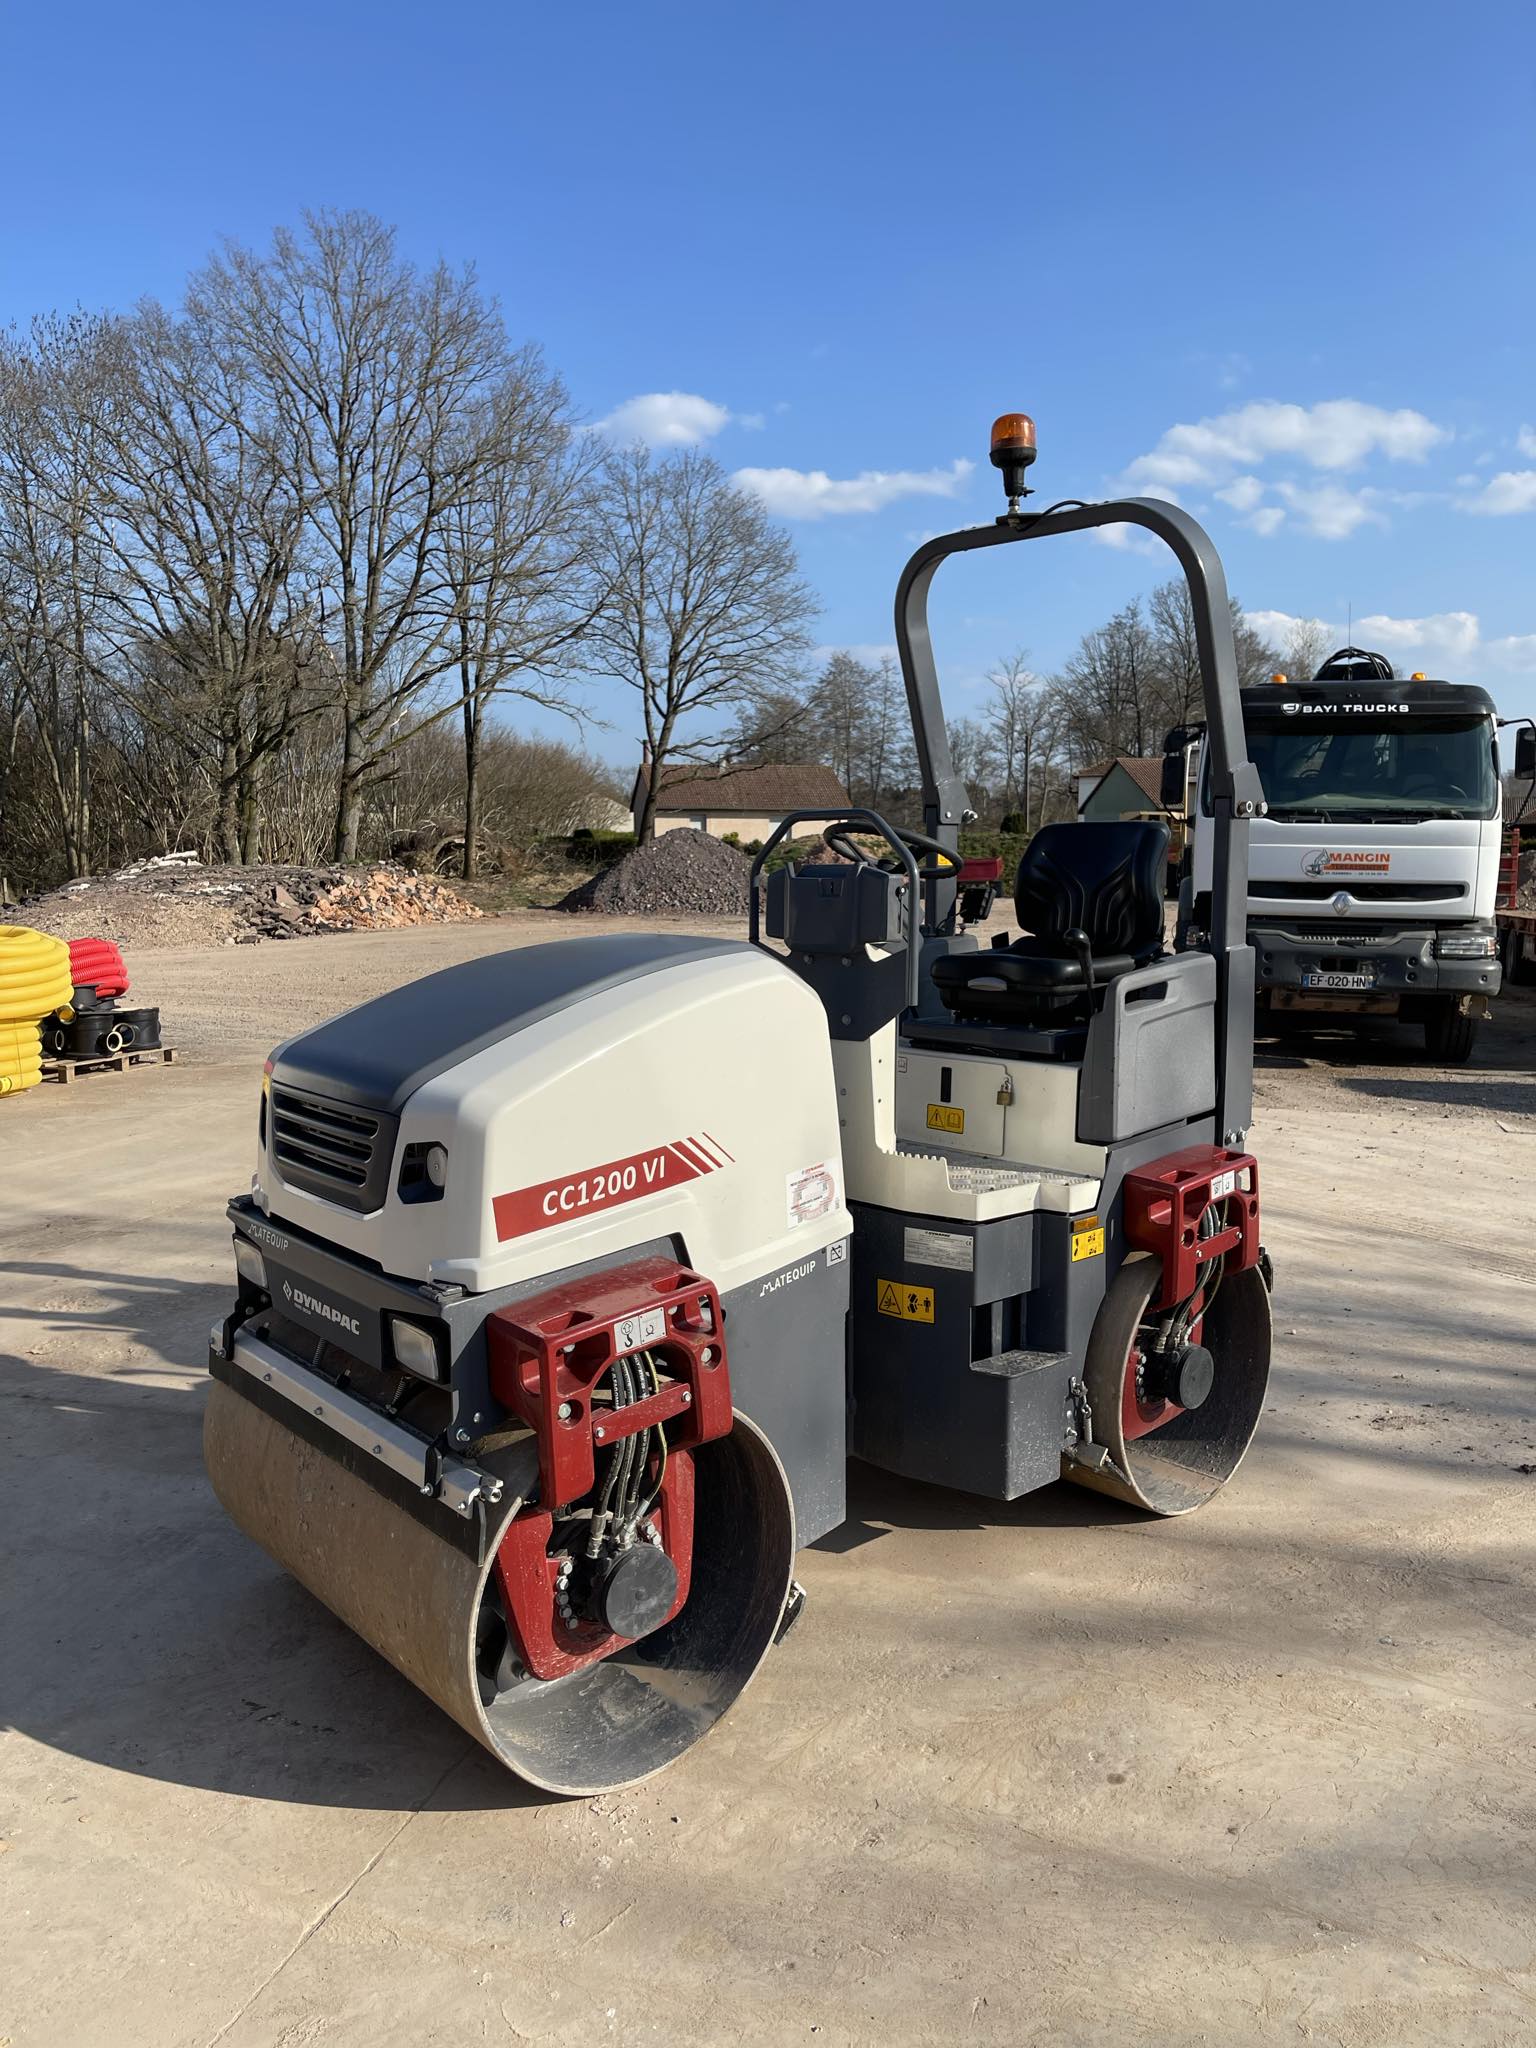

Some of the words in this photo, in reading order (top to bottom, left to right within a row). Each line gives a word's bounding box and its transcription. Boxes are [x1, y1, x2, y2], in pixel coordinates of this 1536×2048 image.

[1303, 704, 1337, 713] BAYI
[1343, 704, 1409, 713] TRUCKS
[1330, 853, 1390, 862] MANGIN
[542, 1166, 637, 1216] CC1200
[642, 1155, 665, 1183] VI
[247, 1223, 289, 1251] MATEQUIP
[760, 1260, 816, 1297] MATEQUIP
[293, 1288, 360, 1336] DYNAPAC
